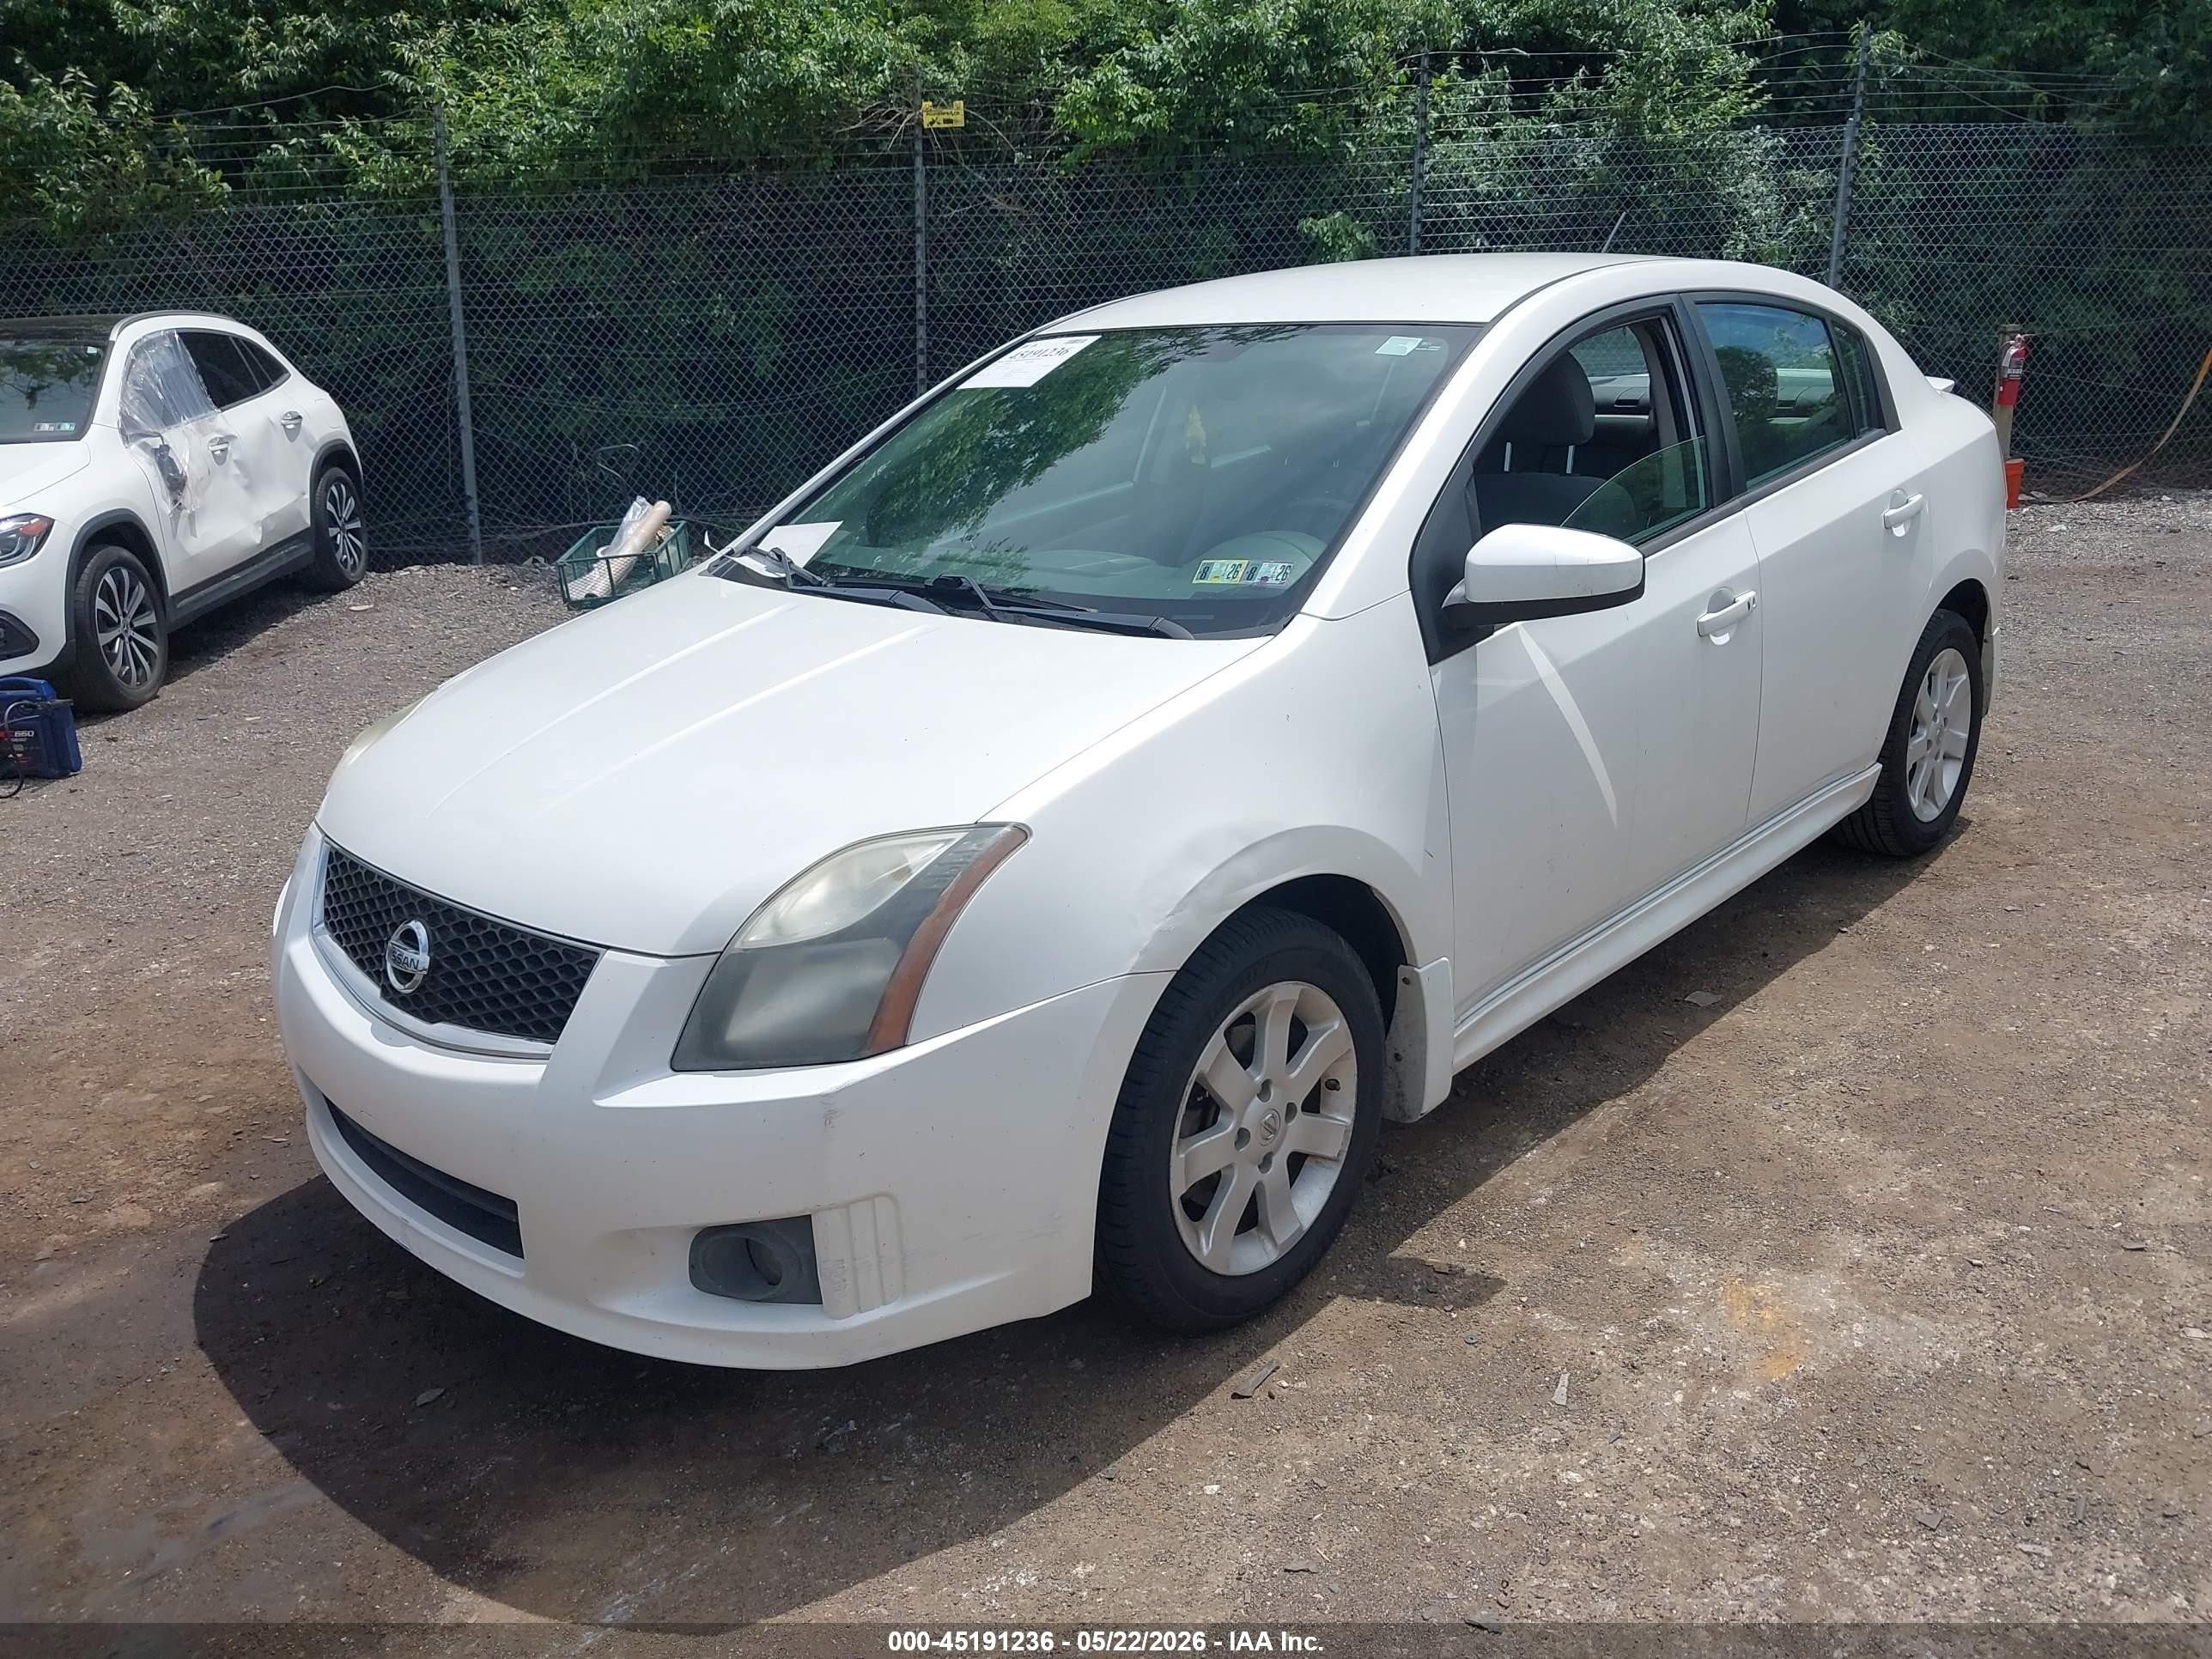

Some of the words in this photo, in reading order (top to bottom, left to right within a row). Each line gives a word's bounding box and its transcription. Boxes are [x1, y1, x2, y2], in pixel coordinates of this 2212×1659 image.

[1199, 566, 1210, 580] 8
[1226, 563, 1243, 580] 26
[1246, 567, 1258, 580] 8
[1275, 564, 1291, 581] 26
